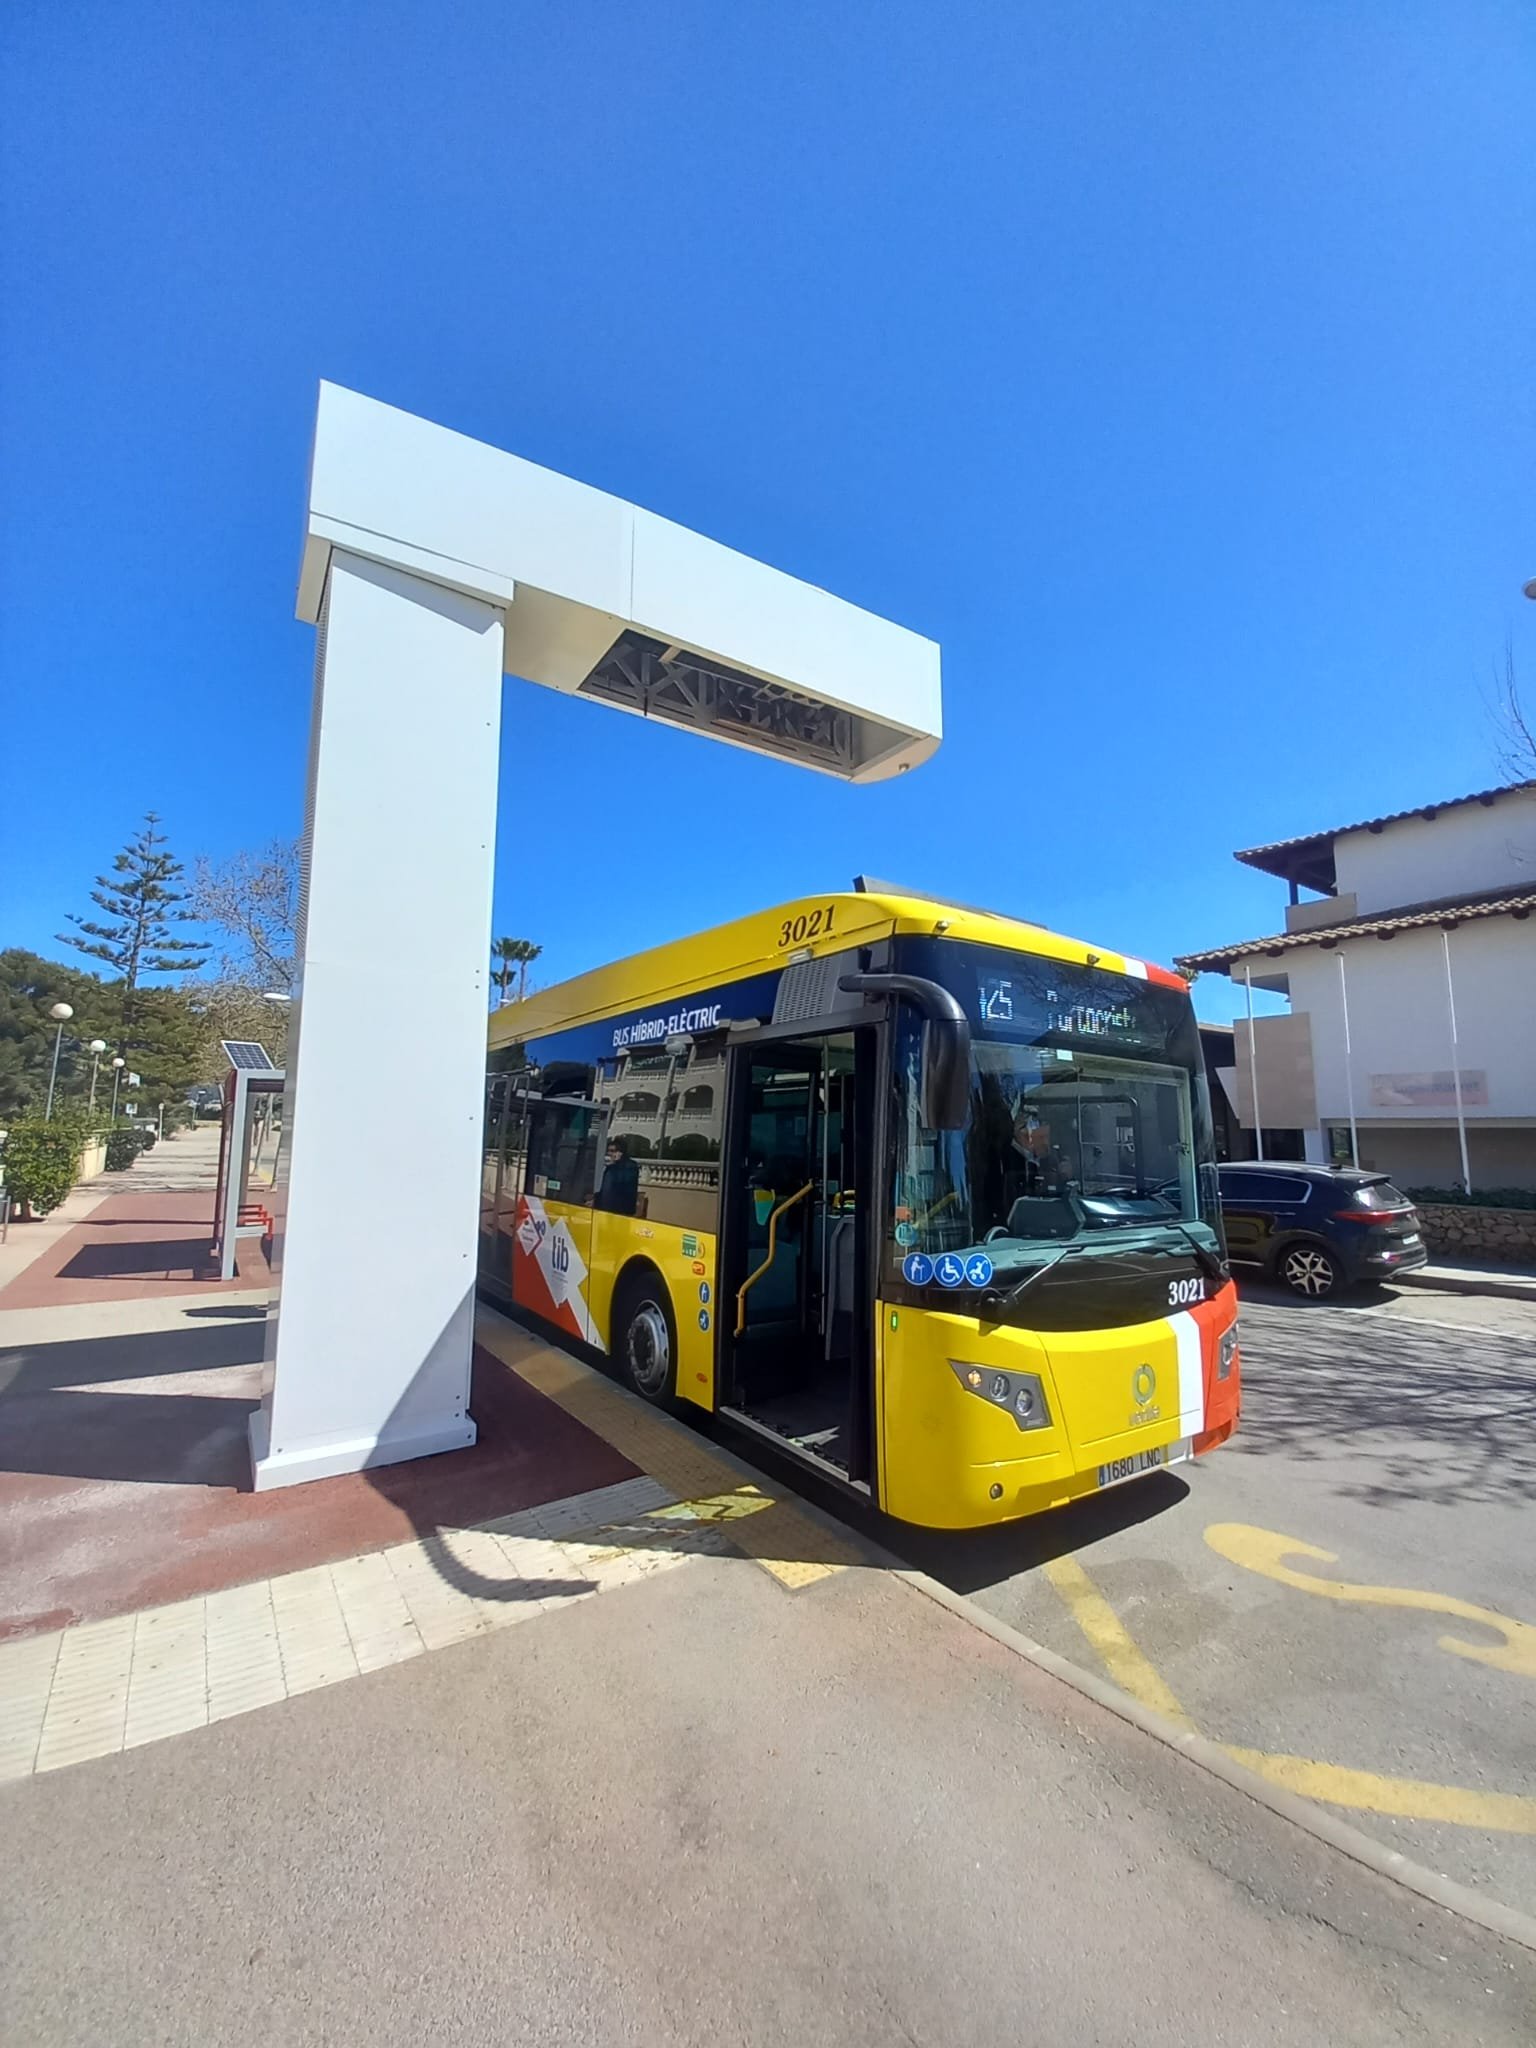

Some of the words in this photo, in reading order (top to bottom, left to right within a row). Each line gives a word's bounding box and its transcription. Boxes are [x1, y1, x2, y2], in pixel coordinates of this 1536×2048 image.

[778, 904, 835, 948] 3021
[612, 1026, 630, 1047] BUS
[630, 1004, 721, 1043] HÍBRID-ELÈCTRIC
[552, 1235, 569, 1272] tib
[1168, 1276, 1205, 1306] 3021
[1106, 1456, 1134, 1482] 1680
[1139, 1446, 1161, 1470] LNC
